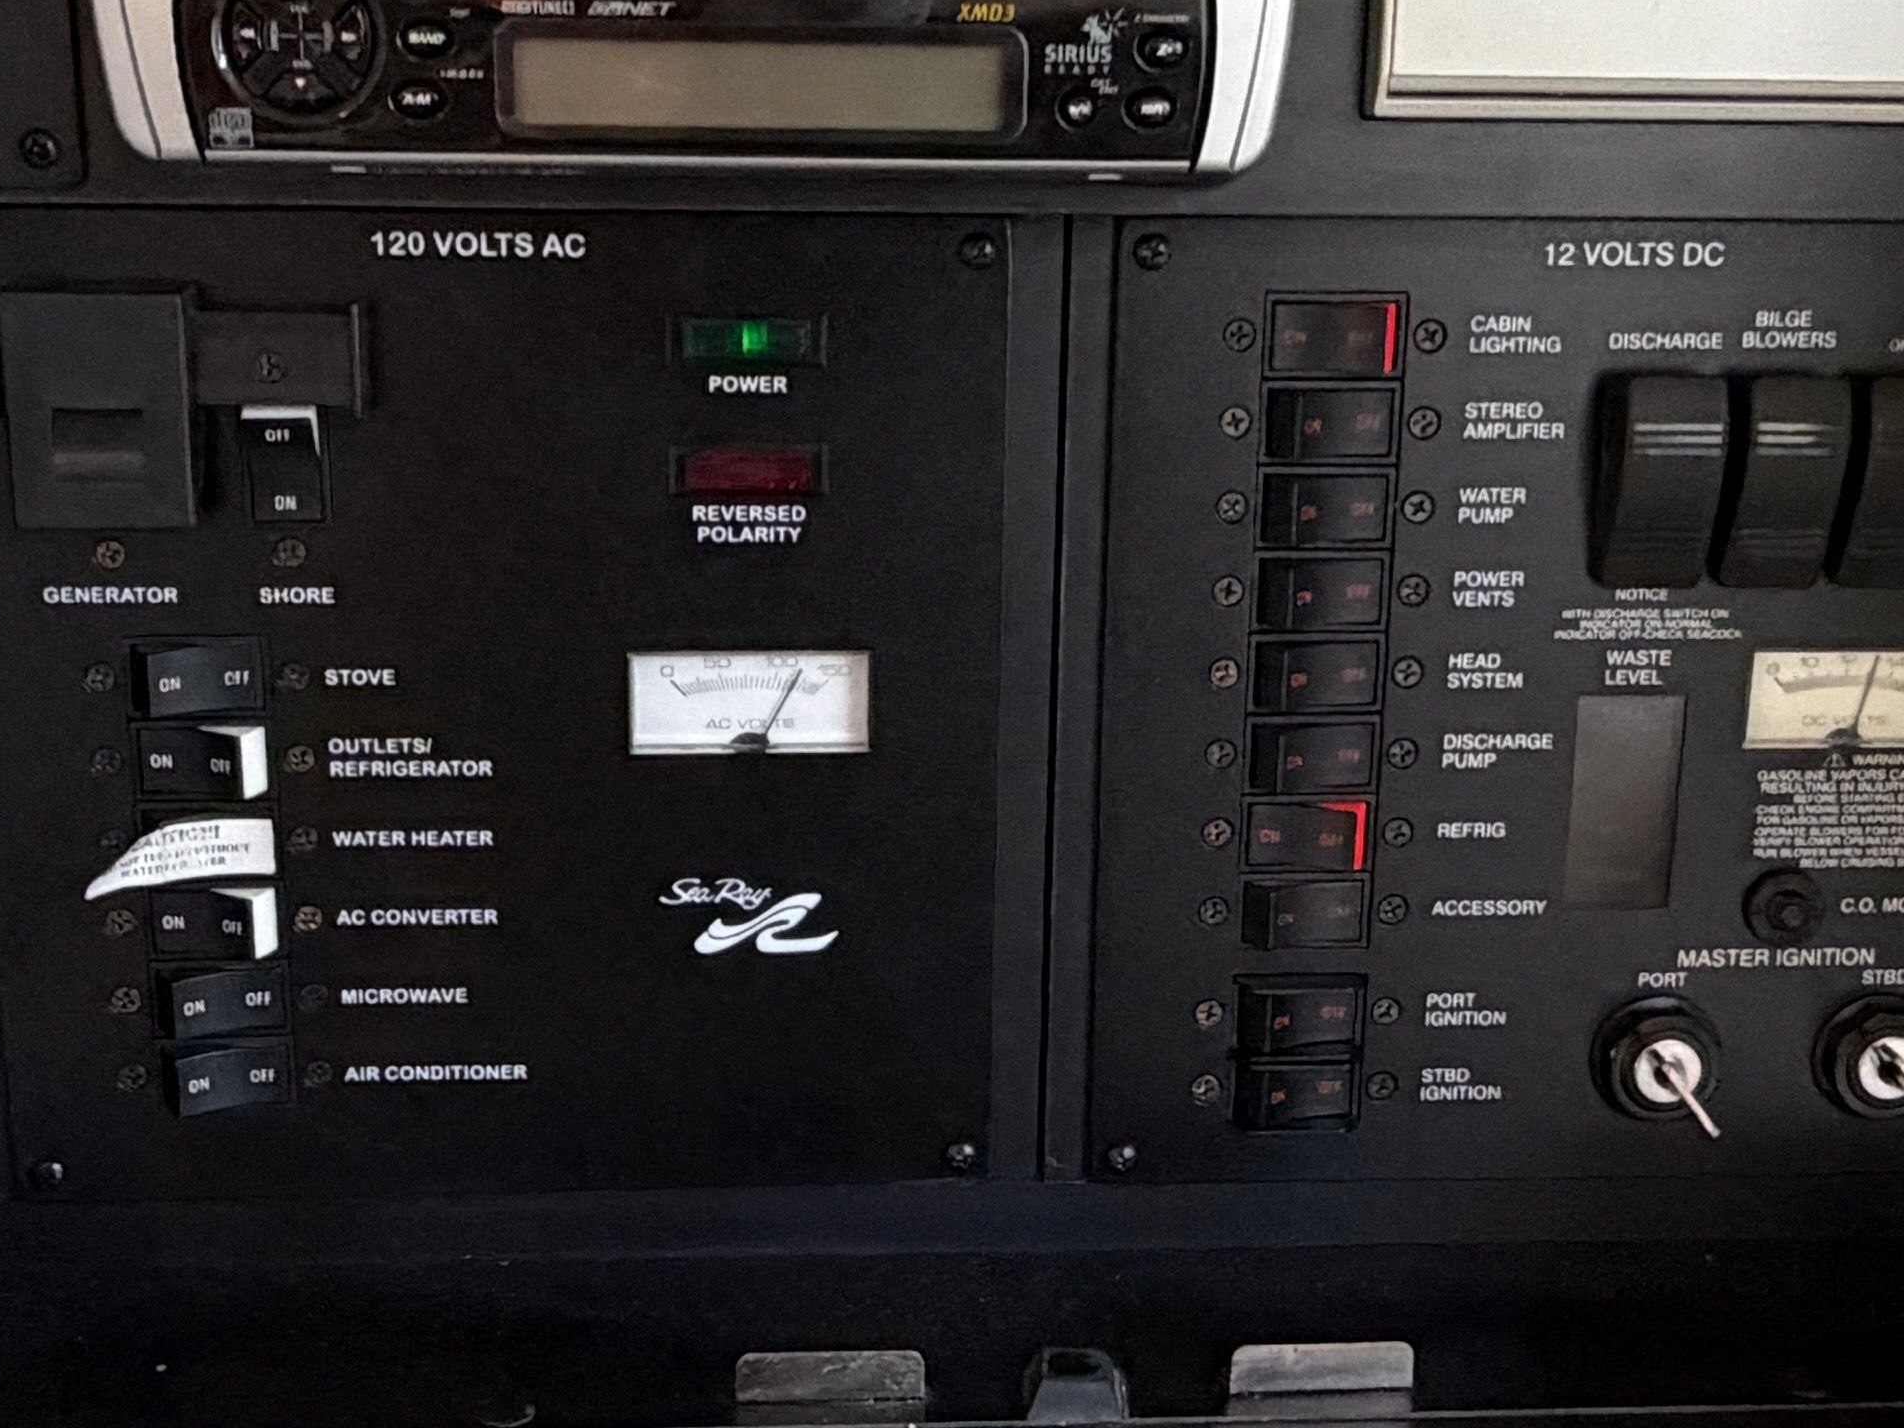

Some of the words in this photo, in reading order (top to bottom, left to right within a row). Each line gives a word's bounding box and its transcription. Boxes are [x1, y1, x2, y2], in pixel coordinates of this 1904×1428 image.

[1045, 43, 1112, 64] SIRIUS
[371, 231, 424, 258] 120
[433, 231, 534, 258] VOLTS
[542, 232, 587, 259] AC
[1543, 243, 1575, 267] 12
[1583, 242, 1677, 268] VOLTS
[1683, 242, 1726, 268] DC
[1471, 315, 1532, 333] CABIN
[1755, 310, 1813, 329] BILGE
[1468, 336, 1562, 354] LIGHTING
[1608, 333, 1724, 351] DISCHARGE
[1741, 332, 1837, 350] BLOWERS
[708, 376, 788, 394] POWER
[1465, 402, 1543, 419] STEREO
[1463, 423, 1565, 440] AMPLIFIER
[274, 496, 297, 511] ON
[1460, 487, 1526, 504] WATER
[692, 504, 807, 523] REVERSED
[1458, 507, 1513, 524] PUMP
[697, 526, 802, 544] POLARITY
[1454, 571, 1525, 587] POWER
[42, 587, 179, 605] GENERATOR
[259, 587, 336, 605] SHORE
[1452, 591, 1515, 607] VENTS
[1615, 588, 1668, 603] NOTICE
[1448, 653, 1501, 670] HEAD
[1606, 649, 1672, 668] WASTE
[159, 676, 182, 692] ON
[324, 670, 397, 686] STOVE
[1447, 673, 1524, 689] SYSTEM
[1604, 670, 1664, 688] LEVEL
[328, 737, 432, 755] OUTLETS/
[1443, 734, 1553, 750] DISCHARGE
[150, 754, 173, 768] ON
[1442, 752, 1496, 768] PUMP
[329, 760, 493, 778] REFRIGERATOR
[332, 830, 405, 847] WATER
[411, 830, 494, 847] HEATER
[1437, 823, 1506, 838] REFRIG
[660, 878, 715, 906] Sea
[714, 878, 772, 908] Ray
[1431, 901, 1547, 916] ACCESSORY
[1840, 896, 1877, 914] C.O.
[162, 915, 185, 930] ON
[336, 909, 365, 926] AC
[371, 909, 498, 926] CONVERTER
[1677, 949, 1770, 967] MASTER
[1775, 948, 1876, 966] IGNITION
[1638, 973, 1687, 988] PORT
[245, 991, 271, 1006] OFF
[341, 988, 469, 1004] MICROWAVE
[1426, 993, 1476, 1009] PORT
[183, 1000, 205, 1016] ON
[1425, 1011, 1506, 1026] IGNITION
[250, 1068, 275, 1083] OFF
[344, 1066, 379, 1081] AIR
[385, 1065, 527, 1080] CONDITIONER
[1421, 1068, 1470, 1083] STBD
[188, 1077, 210, 1092] ON
[1420, 1086, 1502, 1101] IGNITION
